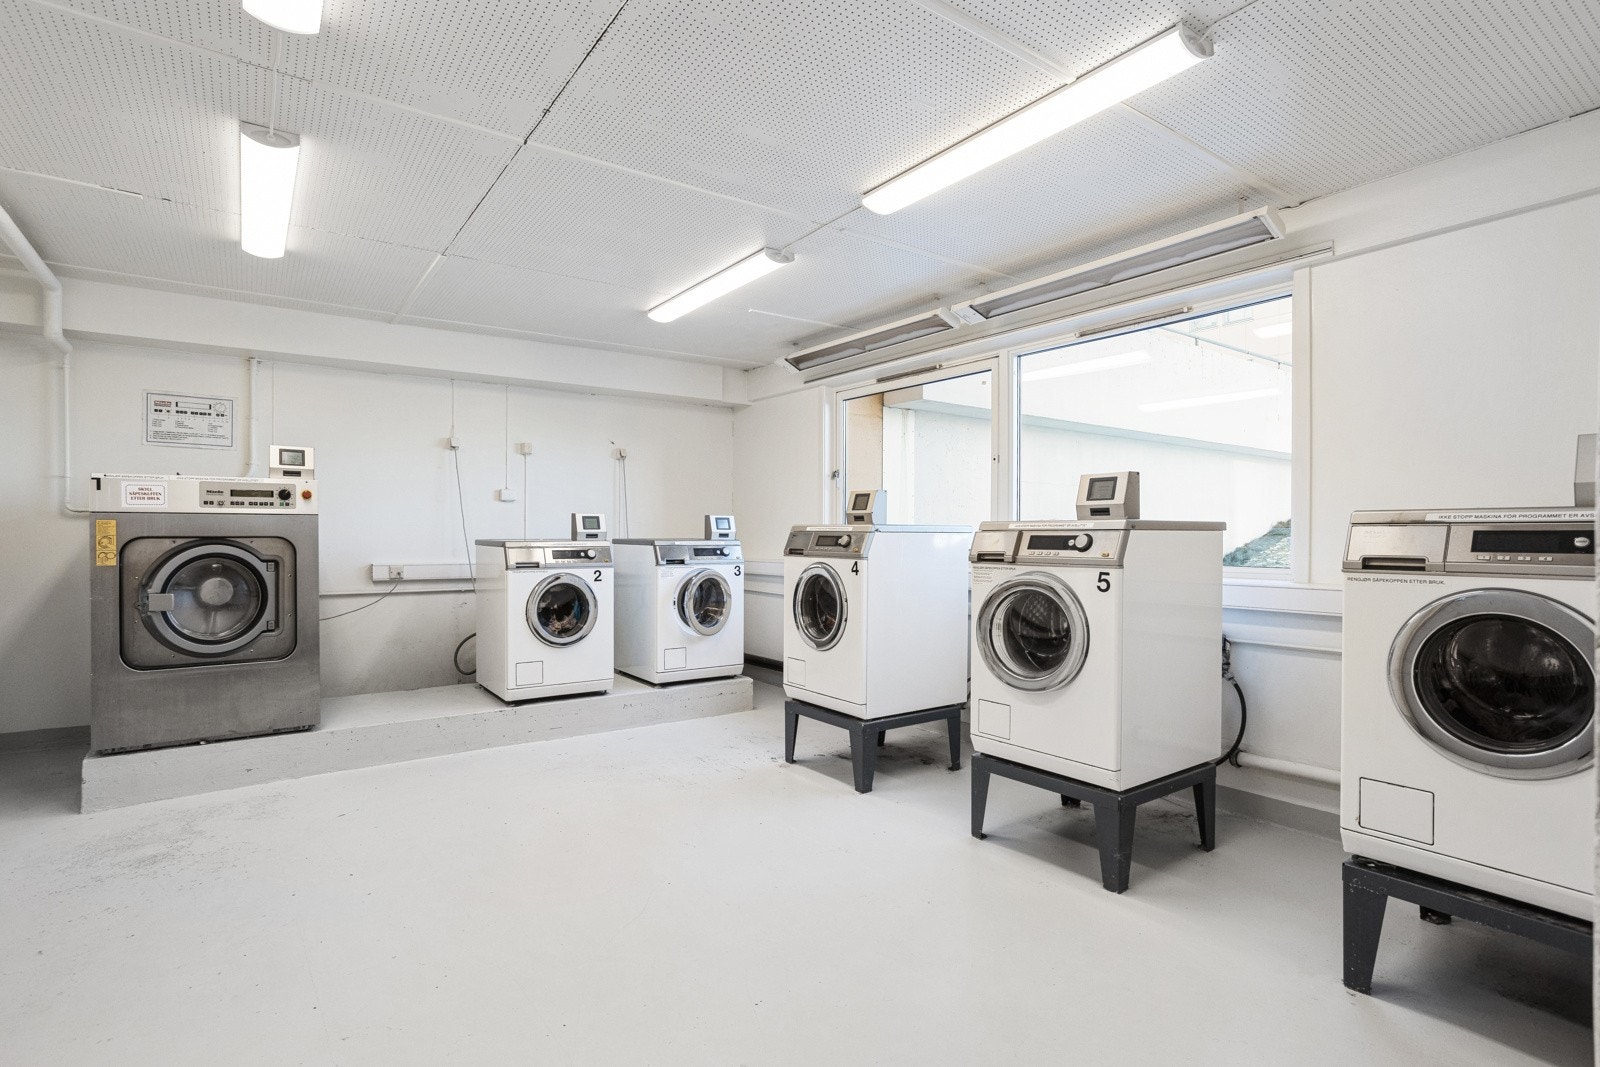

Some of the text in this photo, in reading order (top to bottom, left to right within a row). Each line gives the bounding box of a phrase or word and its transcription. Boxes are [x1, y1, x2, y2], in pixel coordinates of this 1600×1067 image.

[734, 565, 741, 576] 3
[851, 561, 859, 576] 4
[593, 570, 602, 582] 2
[1097, 572, 1111, 593] 5
